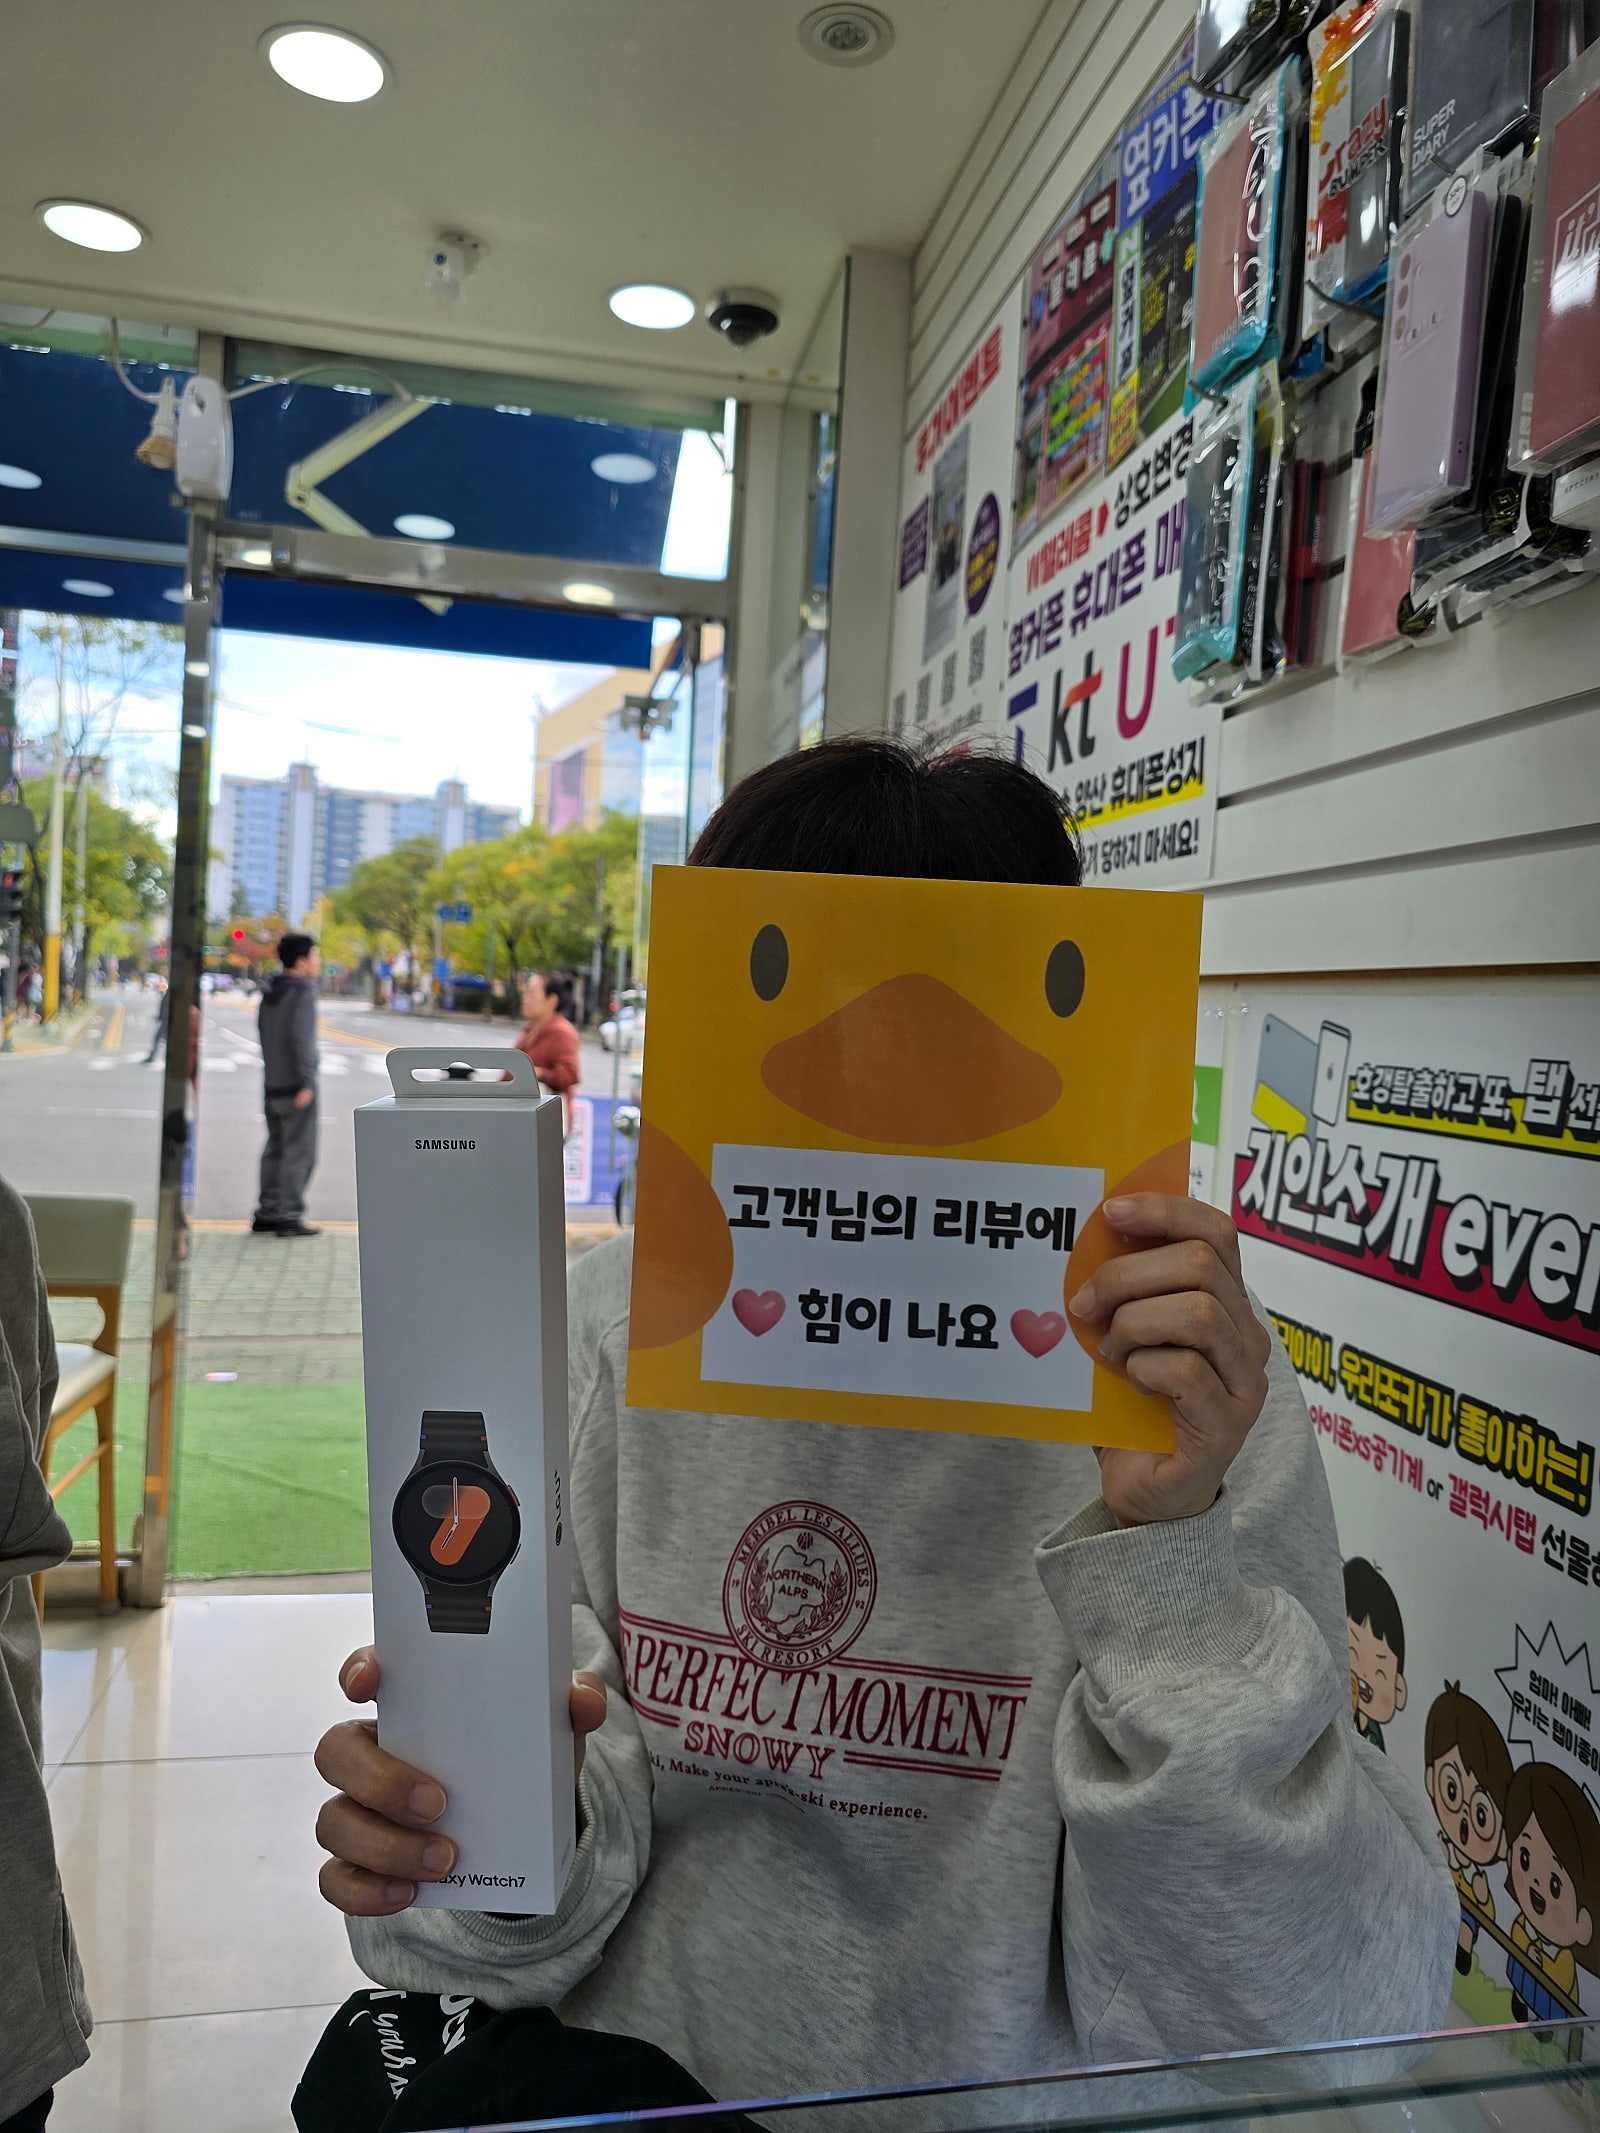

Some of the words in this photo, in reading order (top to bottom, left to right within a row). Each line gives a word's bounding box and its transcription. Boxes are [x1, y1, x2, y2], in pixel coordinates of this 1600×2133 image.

[1412, 124, 1450, 169] DIARY
[1413, 99, 1456, 148] SUPER
[1071, 528, 1146, 637] 휴대폰
[1048, 648, 1104, 774] kt
[1110, 735, 1206, 811] 휴대폰성지
[1101, 831, 1142, 874] 당하지
[1145, 816, 1199, 863] 마세요!
[1352, 1063, 1480, 1118] 호갱탈출하고
[1523, 1059, 1570, 1127] 탭
[1567, 1083, 1600, 1132] 선
[415, 1139, 476, 1150] SAMSUNG
[728, 1184, 917, 1242] 고객님의
[933, 1198, 1077, 1252] 리뷰에
[1238, 1130, 1438, 1267] 지인소개
[798, 1288, 891, 1344] 힘이
[907, 1302, 999, 1350] 나요
[1458, 1400, 1589, 1508] 좋아하는!
[1427, 1478, 1444, 1501] or
[1448, 1472, 1538, 1556] 갤럭시탭
[737, 1509, 797, 1566] MERIBEL
[803, 1508, 833, 1529] LES
[834, 1525, 870, 1588] ALLUES
[766, 1569, 827, 1594] NORTHERN
[778, 1585, 809, 1599] ALPS
[737, 1623, 759, 1651] SKI
[761, 1639, 835, 1666] RESORT
[632, 1633, 820, 1732] PERFECT
[811, 1671, 1029, 1761] MOMENT
[1513, 1690, 1549, 1736] 우리는
[1529, 1669, 1559, 1708] 엄마!
[1561, 1691, 1592, 1732] 아빠!
[684, 1720, 836, 1780] SNOWY
[670, 1757, 709, 1778] Make
[713, 1770, 751, 1786] your
[829, 1799, 928, 1820] experience.
[467, 1873, 527, 1888] Watch7
